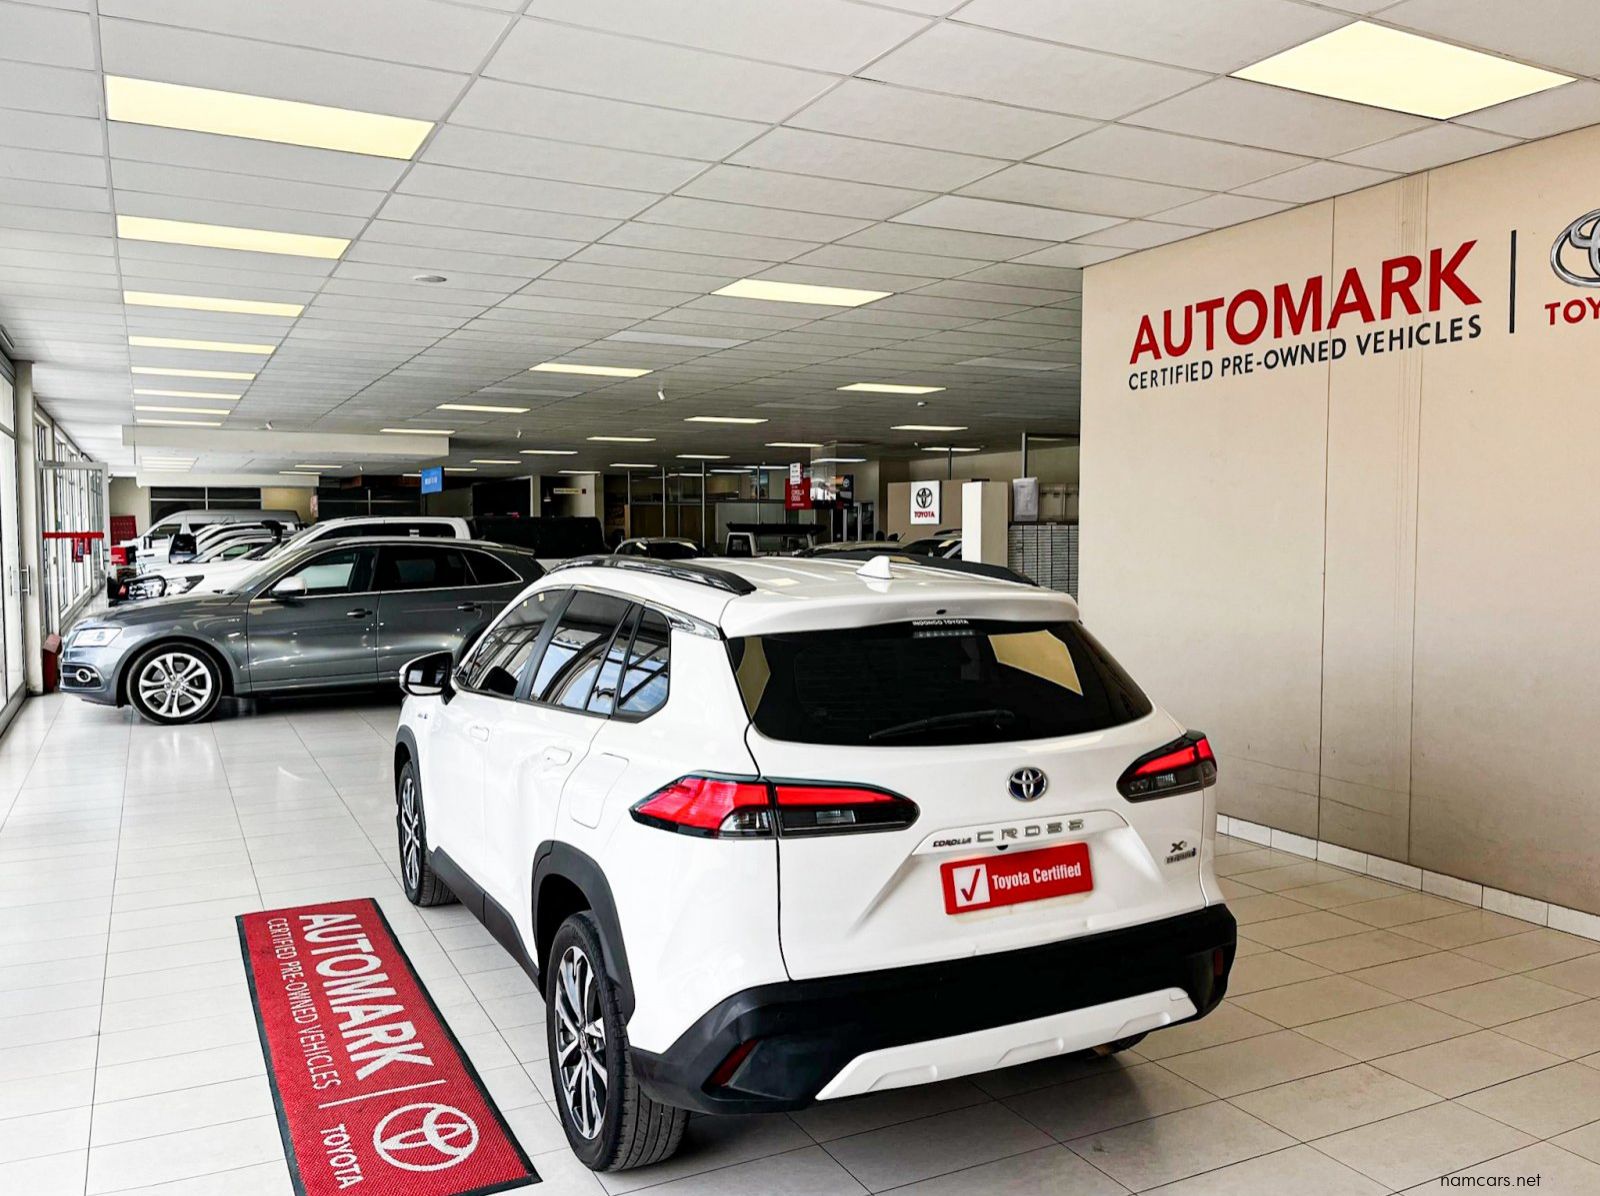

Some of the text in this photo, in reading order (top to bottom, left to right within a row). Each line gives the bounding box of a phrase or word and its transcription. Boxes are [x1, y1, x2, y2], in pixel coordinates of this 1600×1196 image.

[1129, 240, 1482, 364] AUTOMARK
[1128, 314, 1482, 391] CERTIFIED PRE-OWNED VEHICLES
[932, 818, 1085, 848] COROLLA CROSS
[992, 861, 1082, 890] Toyota Certified
[267, 917, 342, 1090] CERTIFIED PRE-OWNED VEHICLES
[299, 913, 434, 1081] AUTOMARK
[320, 1123, 364, 1190] TOYOTA
